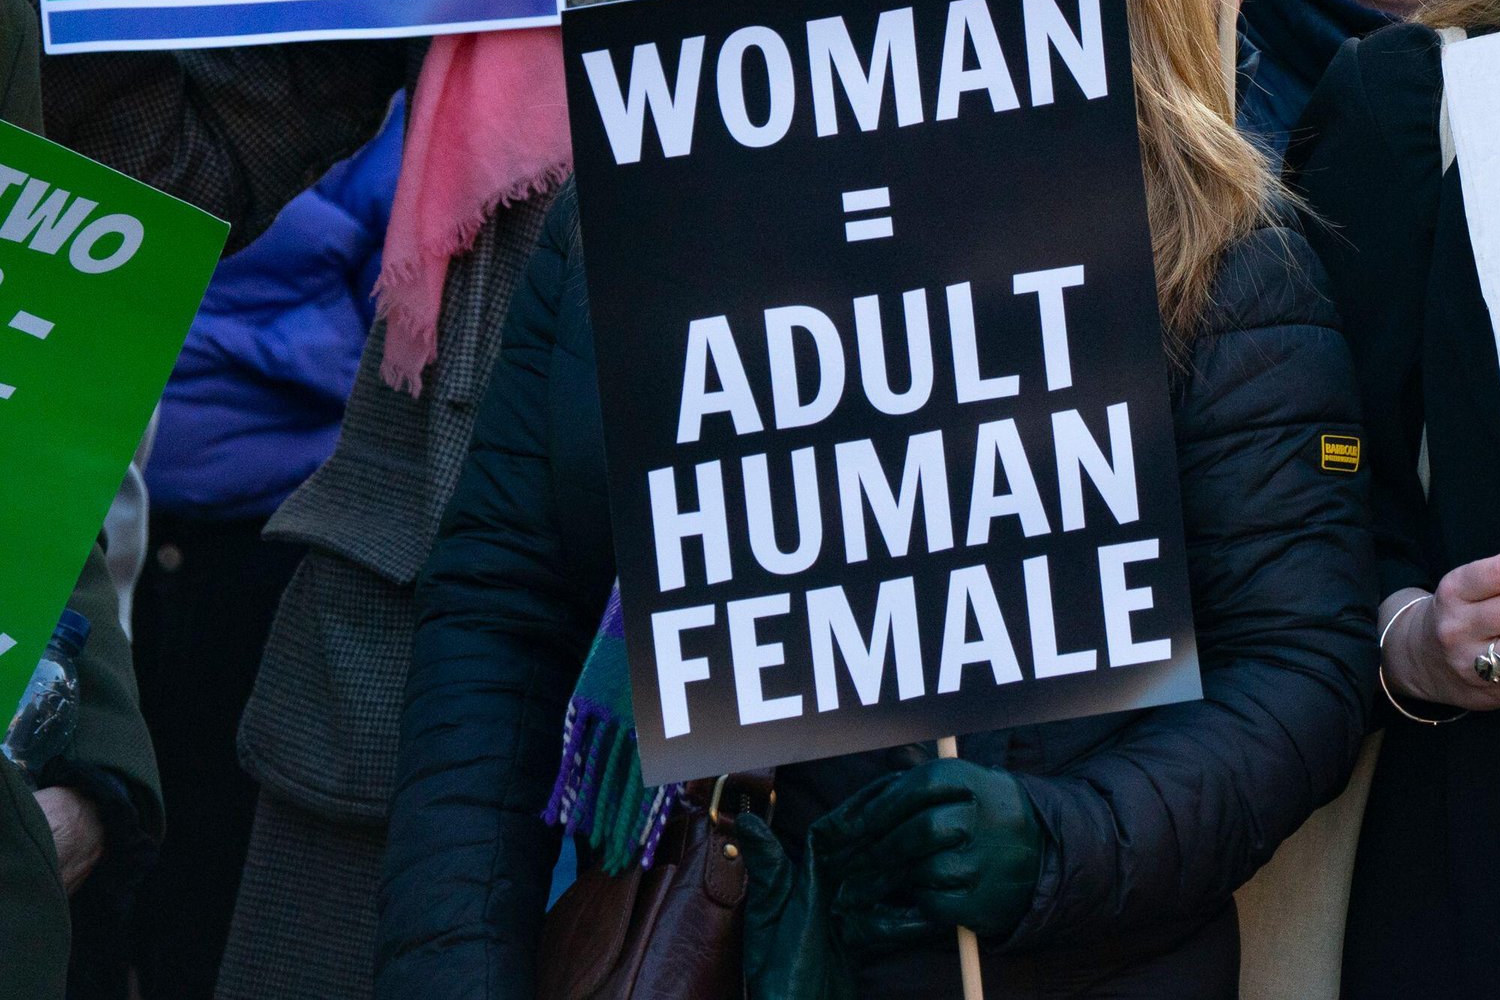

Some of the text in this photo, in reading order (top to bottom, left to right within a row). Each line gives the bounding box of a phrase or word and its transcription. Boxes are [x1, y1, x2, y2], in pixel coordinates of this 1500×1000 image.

[676, 264, 1086, 444] ADULT
[647, 401, 1141, 592] HUMAN
[651, 537, 1173, 740] FEMALE
